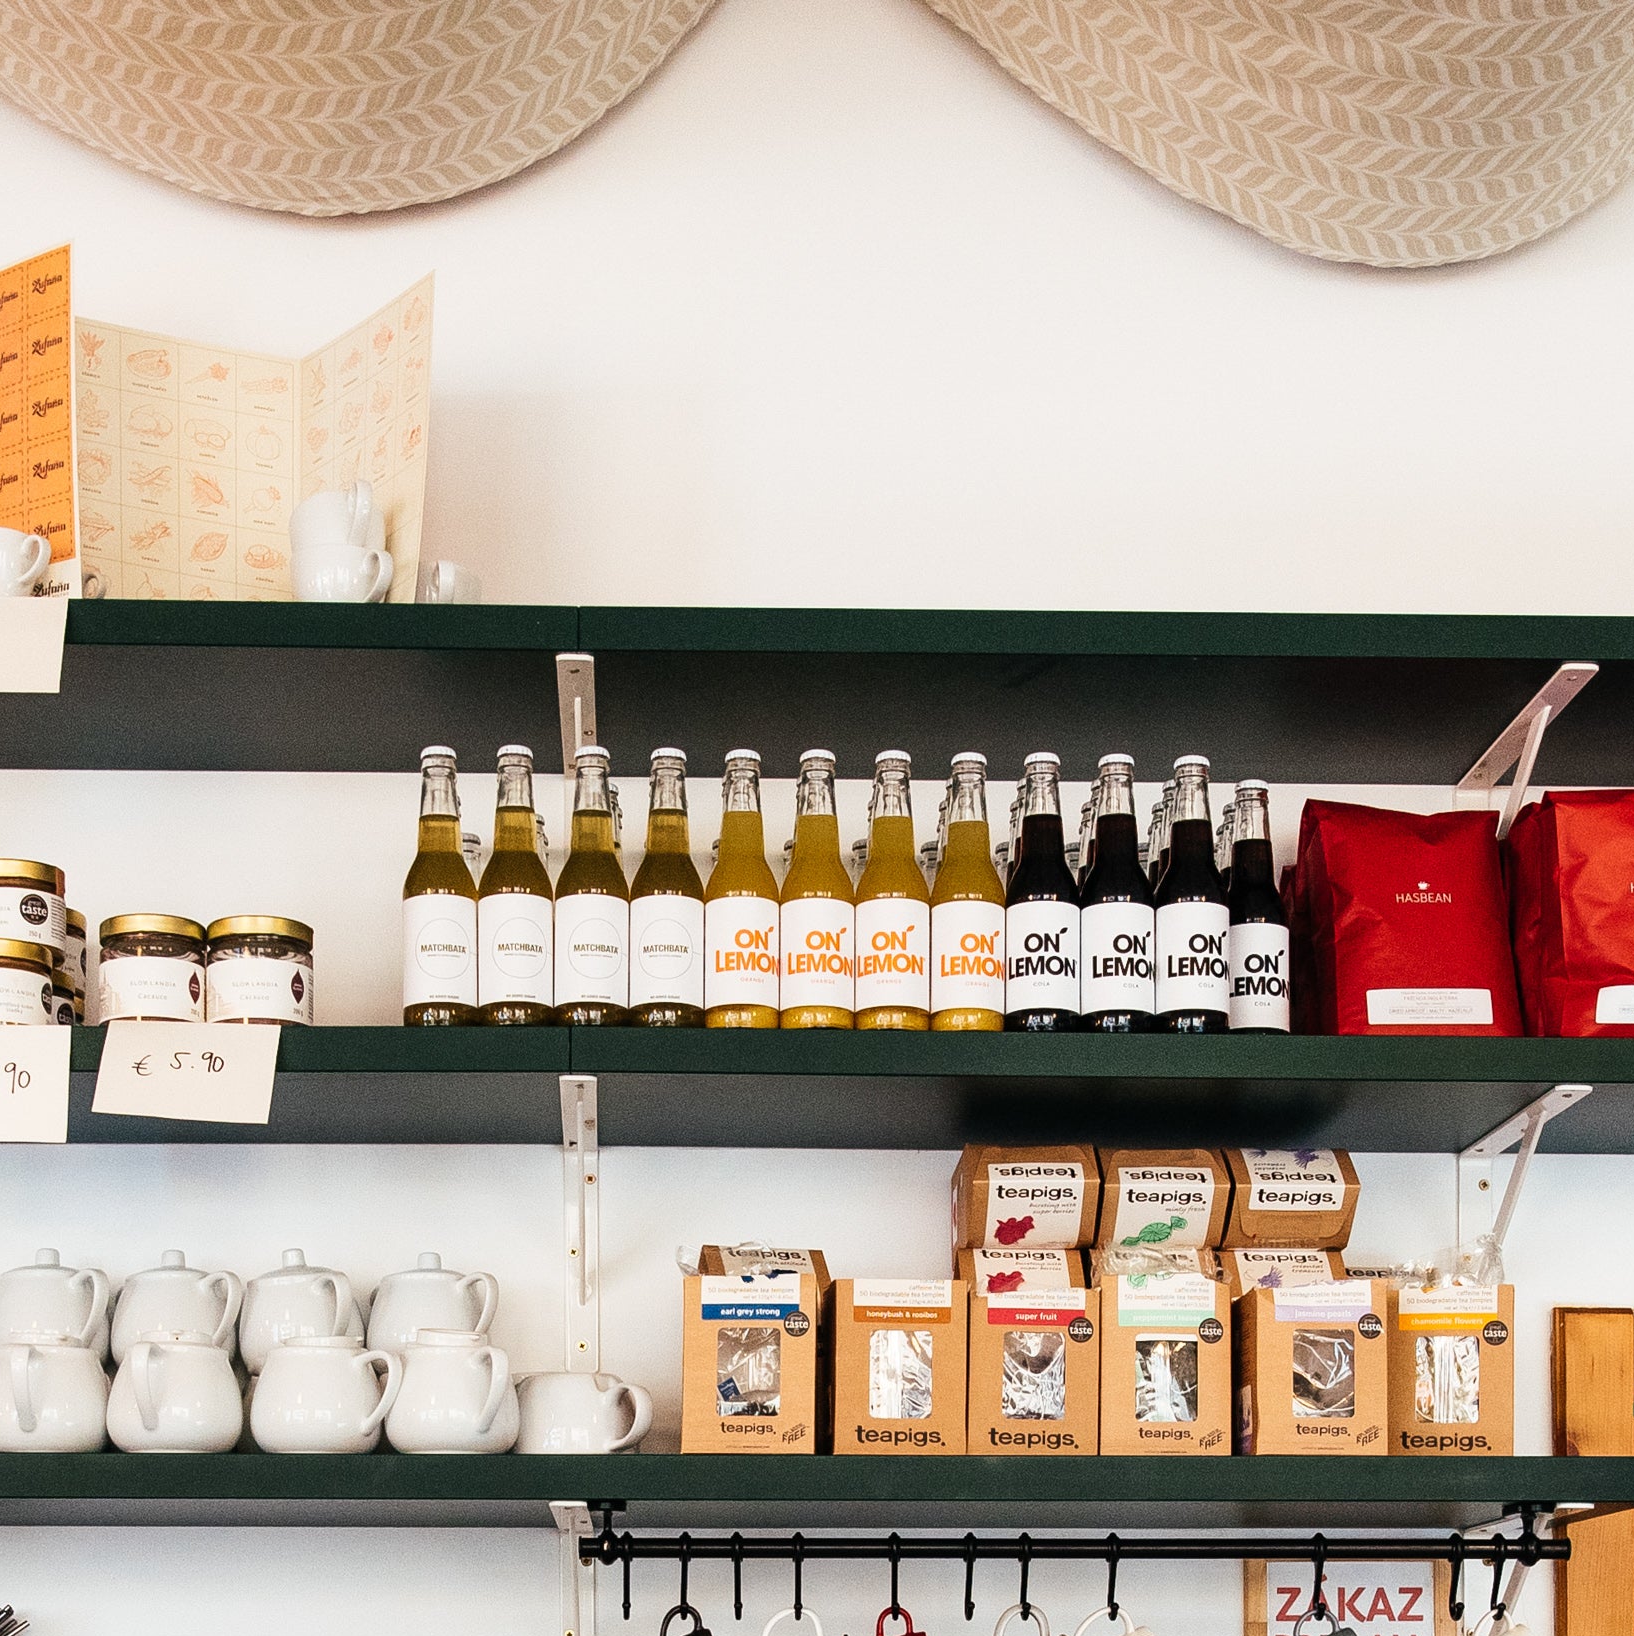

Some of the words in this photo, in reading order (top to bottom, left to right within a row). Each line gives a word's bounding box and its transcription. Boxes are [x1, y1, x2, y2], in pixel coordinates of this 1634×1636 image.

[1395, 891, 1452, 904] HASBEAN
[22, 904, 47, 917] taste
[735, 929, 769, 950] ON
[805, 930, 841, 952] ON
[871, 931, 907, 951] ON
[960, 933, 994, 955] ON
[1024, 933, 1061, 954] ON
[1113, 934, 1147, 956] ON
[1188, 933, 1223, 956] ON
[420, 943, 467, 954] MATCHBATA
[497, 943, 543, 954] MATCHBATA
[573, 943, 619, 954] MATCHBATA
[642, 944, 689, 954] MATCHBATA
[715, 950, 780, 977] LEMON
[787, 952, 853, 979] LEMON
[857, 953, 924, 978] LEMON
[940, 954, 1005, 981] LEMON
[1008, 955, 1076, 981] LEMON
[1092, 955, 1155, 981] LEMON
[1244, 953, 1279, 975] ON
[132, 1054, 152, 1076] €
[994, 1166, 1078, 1180] teapigs.
[1125, 1169, 1208, 1184] teapigs.
[1254, 1172, 1337, 1184] teapigs.
[996, 1185, 1078, 1201] teapigs.
[1126, 1188, 1207, 1205] teapigs.
[1257, 1188, 1337, 1205] teapigs.
[982, 1249, 1061, 1262] teapigs.
[1243, 1252, 1323, 1265] teapigs.
[720, 1308, 735, 1316] earl
[737, 1309, 754, 1318] grey
[756, 1307, 780, 1318] strong
[1015, 1313, 1038, 1322] super
[1039, 1311, 1058, 1321] fruit
[1295, 1308, 1327, 1318] jasmine
[1328, 1308, 1352, 1319] pearls
[785, 1320, 809, 1329] taste
[1069, 1325, 1093, 1335] taste
[1200, 1327, 1222, 1336] taste
[1359, 1322, 1382, 1331] taste
[1484, 1328, 1507, 1337] taste
[721, 1421, 776, 1436] teapigs.
[781, 1427, 806, 1445] FREE
[855, 1424, 946, 1447] teapigs.
[1139, 1426, 1194, 1441] teapigs.
[1296, 1423, 1351, 1437] teapigs.
[989, 1426, 1079, 1450] teapigs.
[1198, 1434, 1225, 1451] FREE
[1355, 1429, 1380, 1447] FREE
[1400, 1430, 1492, 1452] teapigs.
